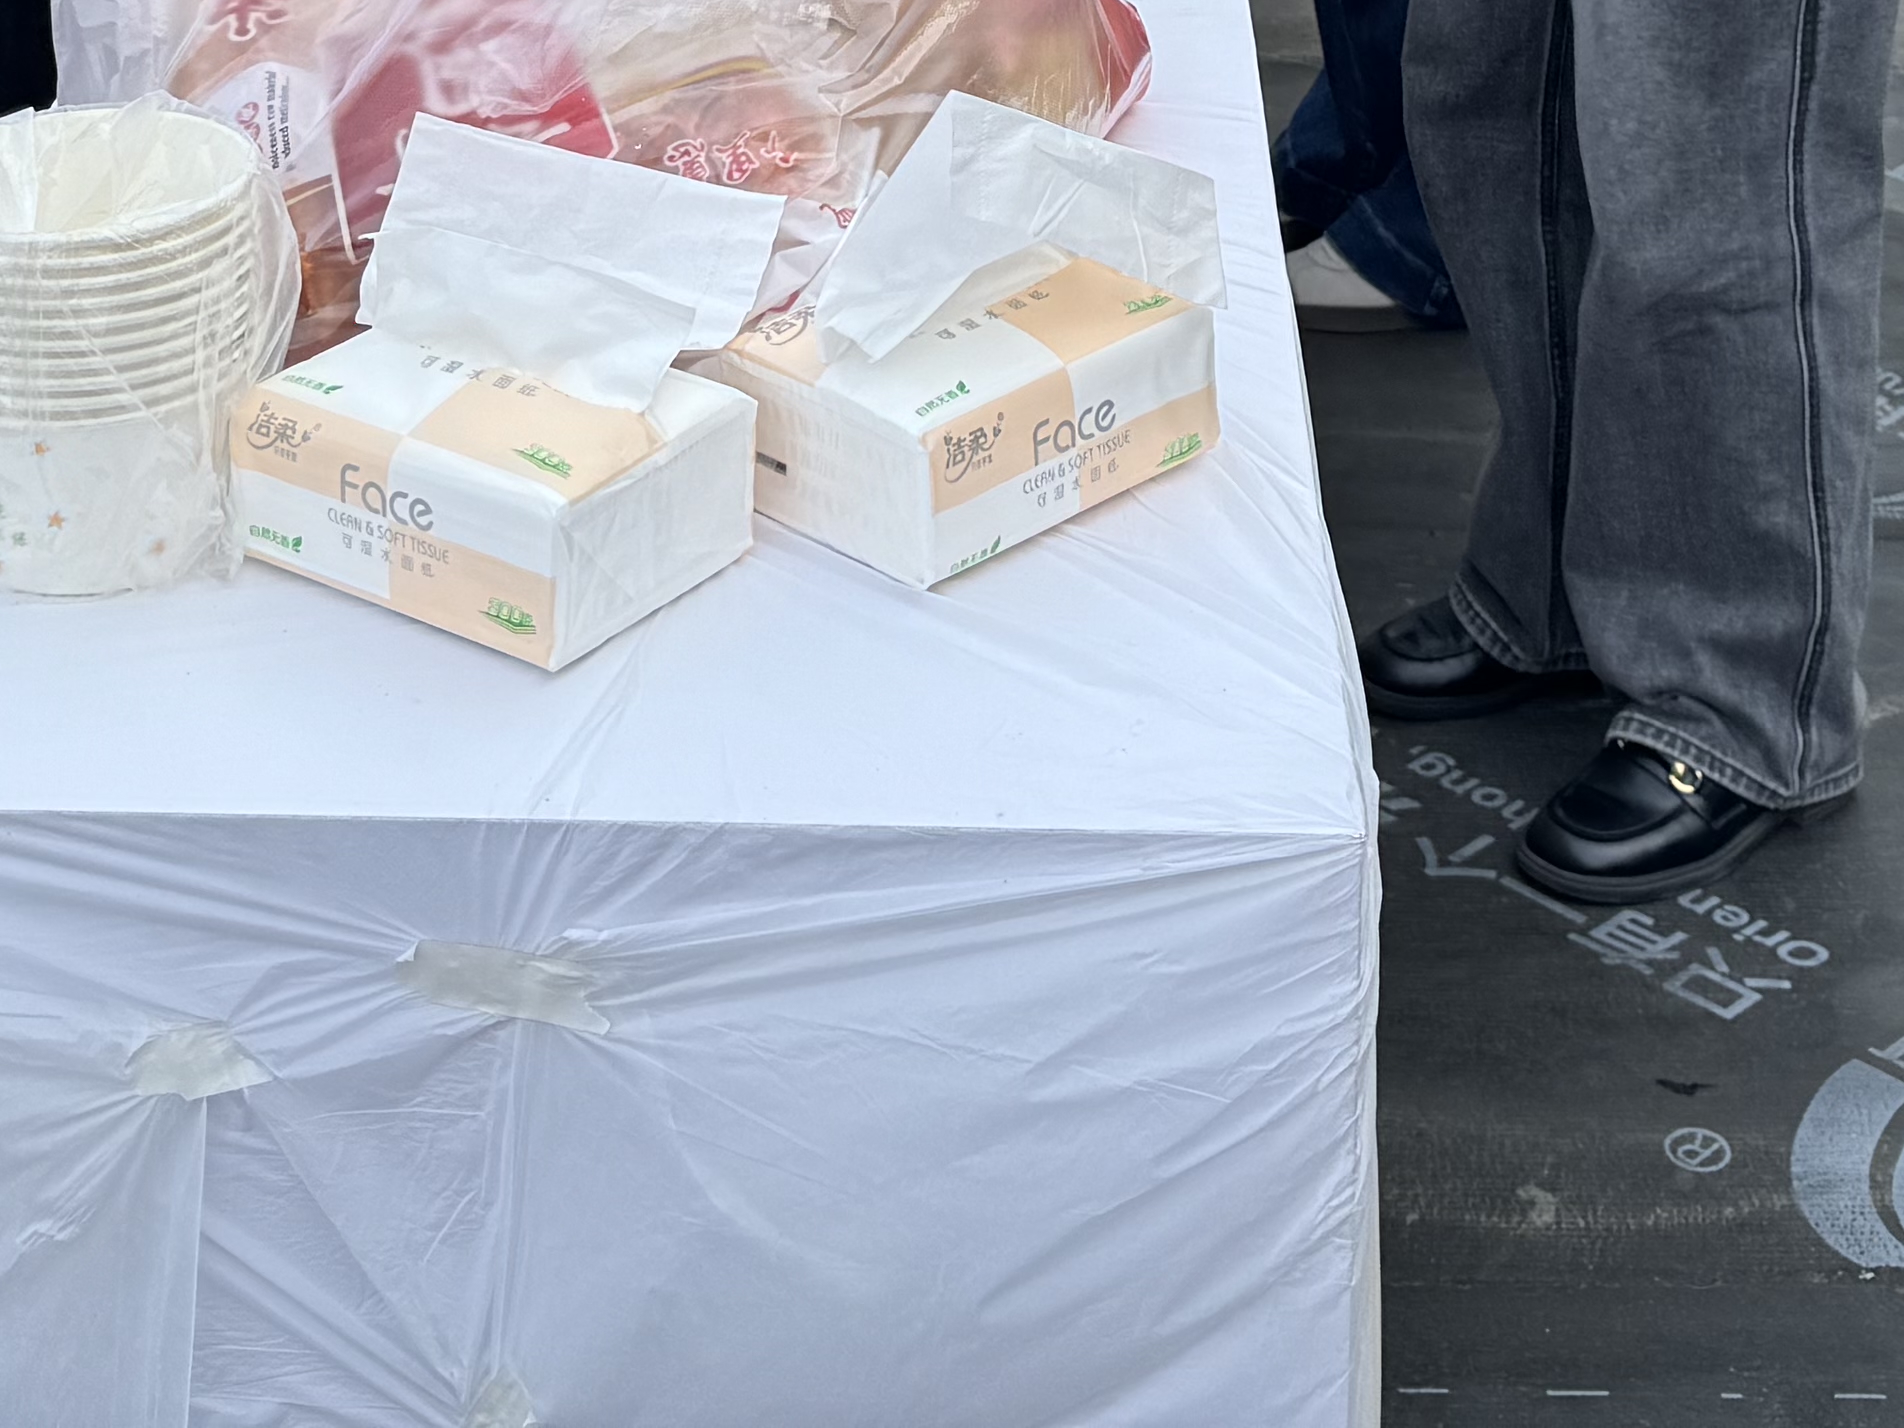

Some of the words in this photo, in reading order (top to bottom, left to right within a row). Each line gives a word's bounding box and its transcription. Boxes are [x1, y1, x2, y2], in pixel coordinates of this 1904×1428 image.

[247, 412, 299, 444] 洁柔
[945, 426, 988, 469] 洁柔
[1022, 469, 1056, 495] CLEAN
[1068, 450, 1095, 473] SOFT
[1097, 428, 1132, 460] TISSUE
[1033, 399, 1117, 466] Face
[339, 463, 434, 532] Face
[327, 507, 363, 534] CLEAN
[376, 524, 407, 549] SOFT
[409, 535, 450, 565] TISSUE
[1406, 744, 1541, 832] hong,
[1676, 887, 1831, 968] Orien
